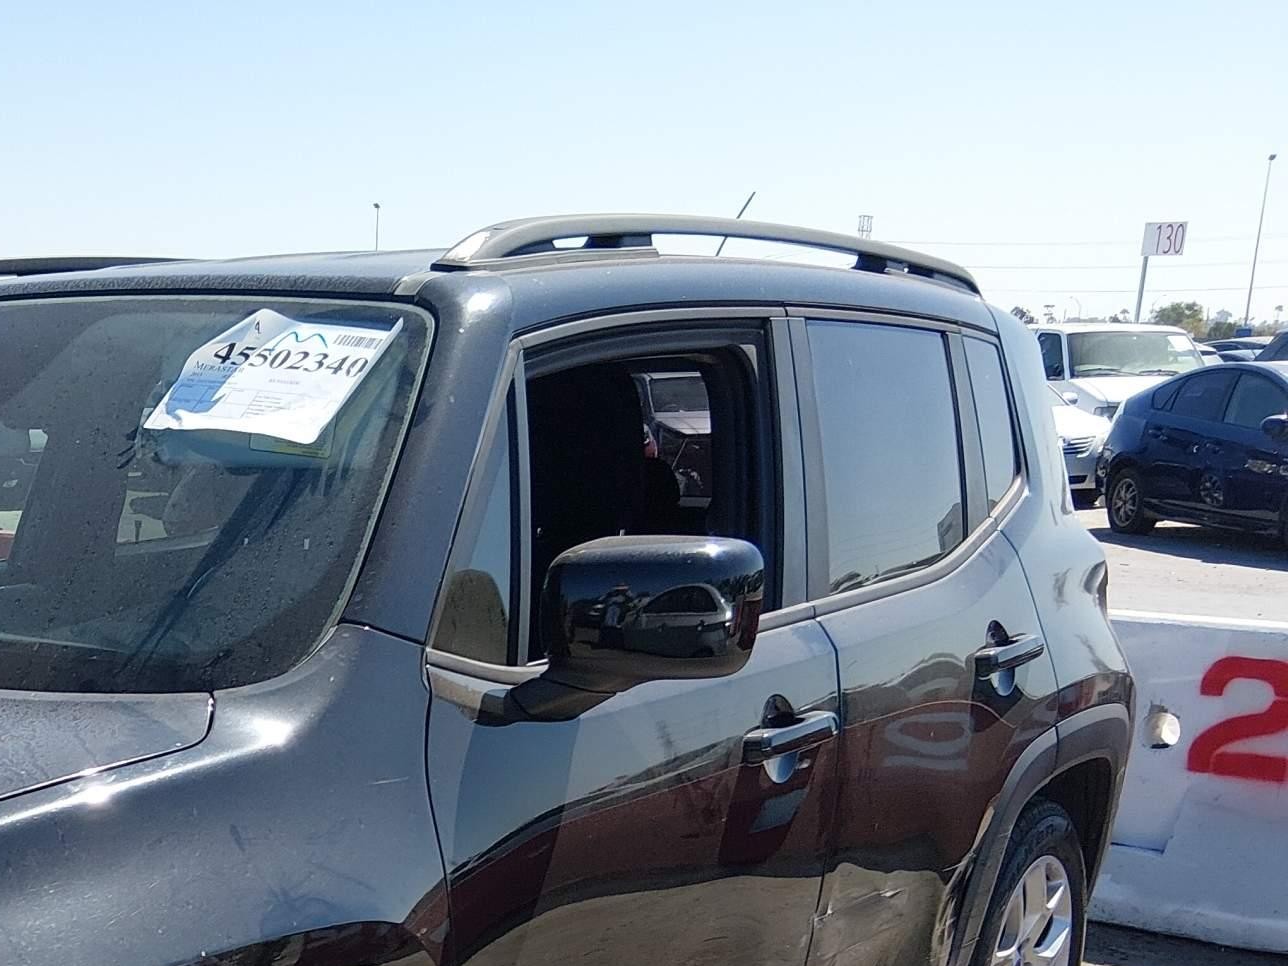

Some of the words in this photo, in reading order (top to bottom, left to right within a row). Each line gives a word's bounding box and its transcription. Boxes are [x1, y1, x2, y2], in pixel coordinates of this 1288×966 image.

[1155, 223, 1184, 254] 130
[214, 342, 369, 378] 45502340
[1187, 656, 1288, 782] 2
